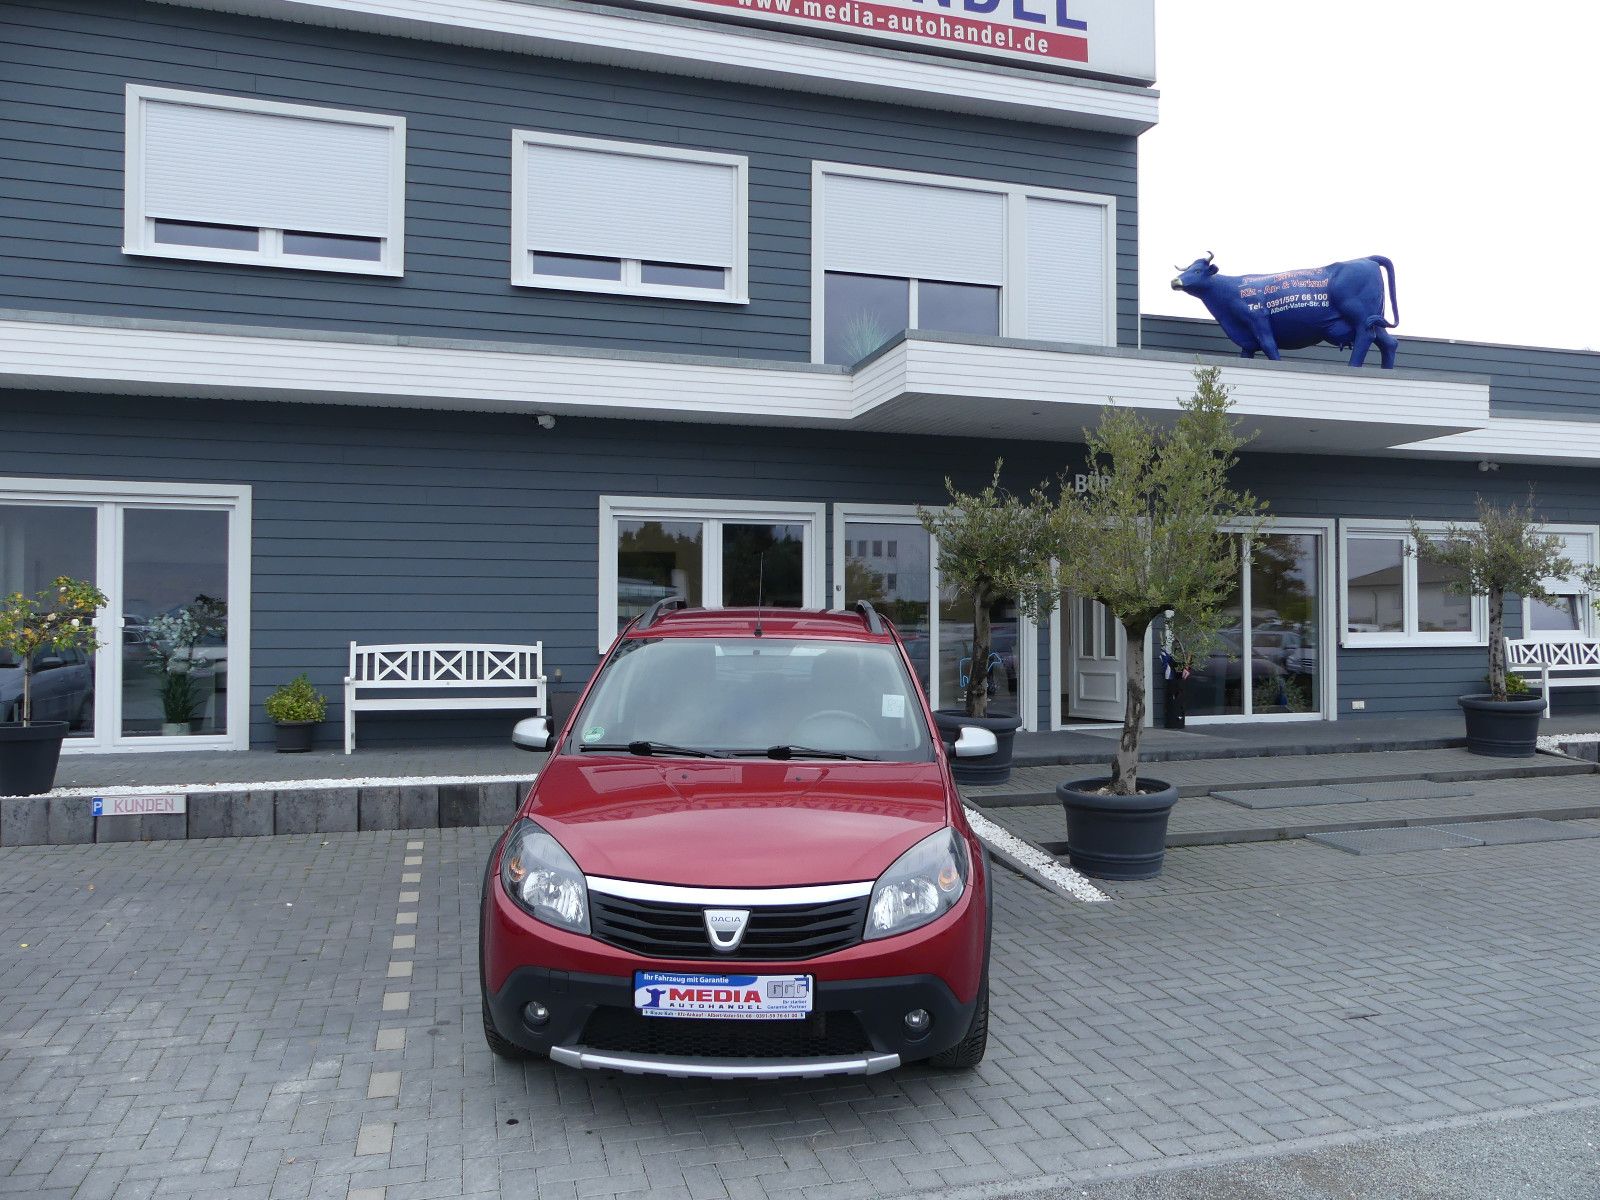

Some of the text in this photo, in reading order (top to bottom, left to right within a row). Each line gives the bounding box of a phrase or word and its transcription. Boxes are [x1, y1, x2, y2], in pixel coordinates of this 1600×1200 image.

[1247, 303, 1263, 311] Tel.
[1266, 294, 1300, 309] 0391/597
[1313, 293, 1328, 301] 100
[93, 798, 174, 813] P KUNDEN
[654, 975, 686, 984] Fahrzeug
[699, 976, 729, 984] Garantie
[669, 988, 762, 1003] MEDIA
